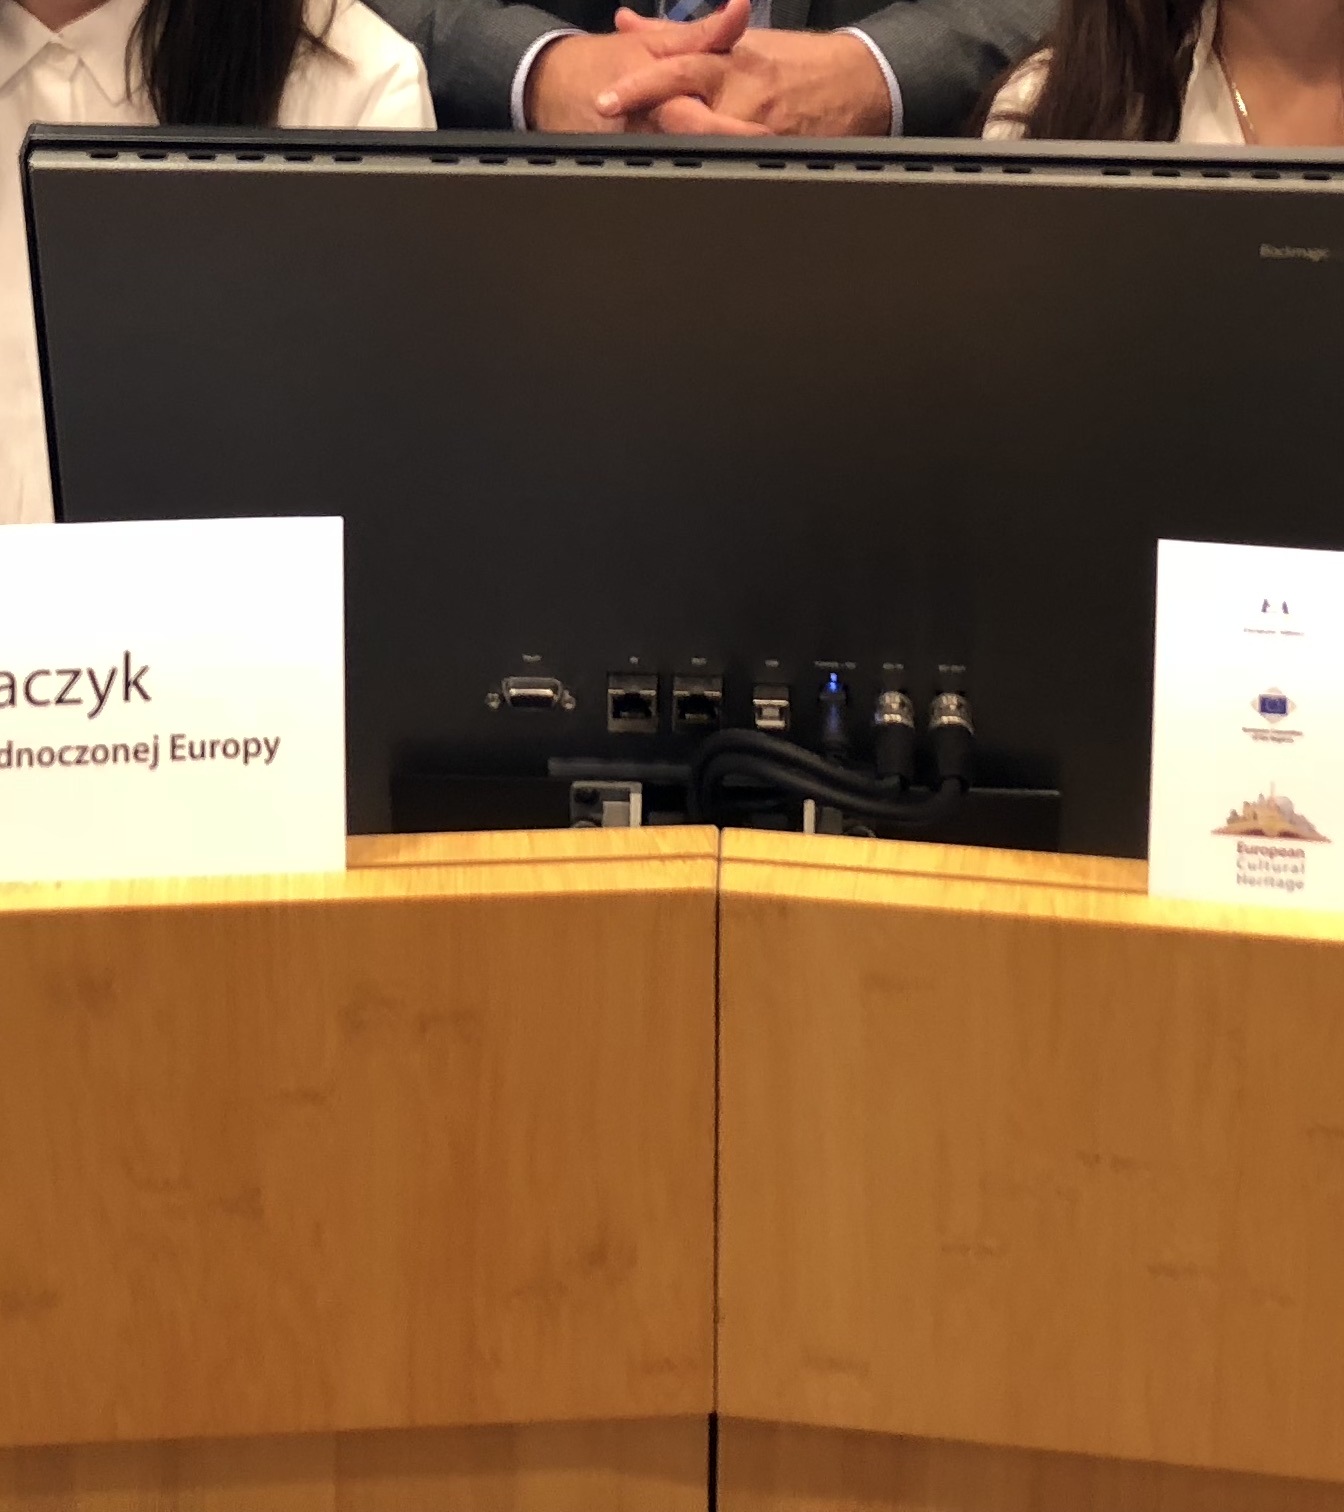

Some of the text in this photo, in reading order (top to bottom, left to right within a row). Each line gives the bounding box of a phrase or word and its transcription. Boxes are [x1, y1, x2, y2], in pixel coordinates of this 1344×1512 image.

[169, 732, 281, 768] Europy
[1236, 841, 1306, 859] European
[1236, 858, 1305, 876] Cultural
[1236, 873, 1305, 893] Heritage
